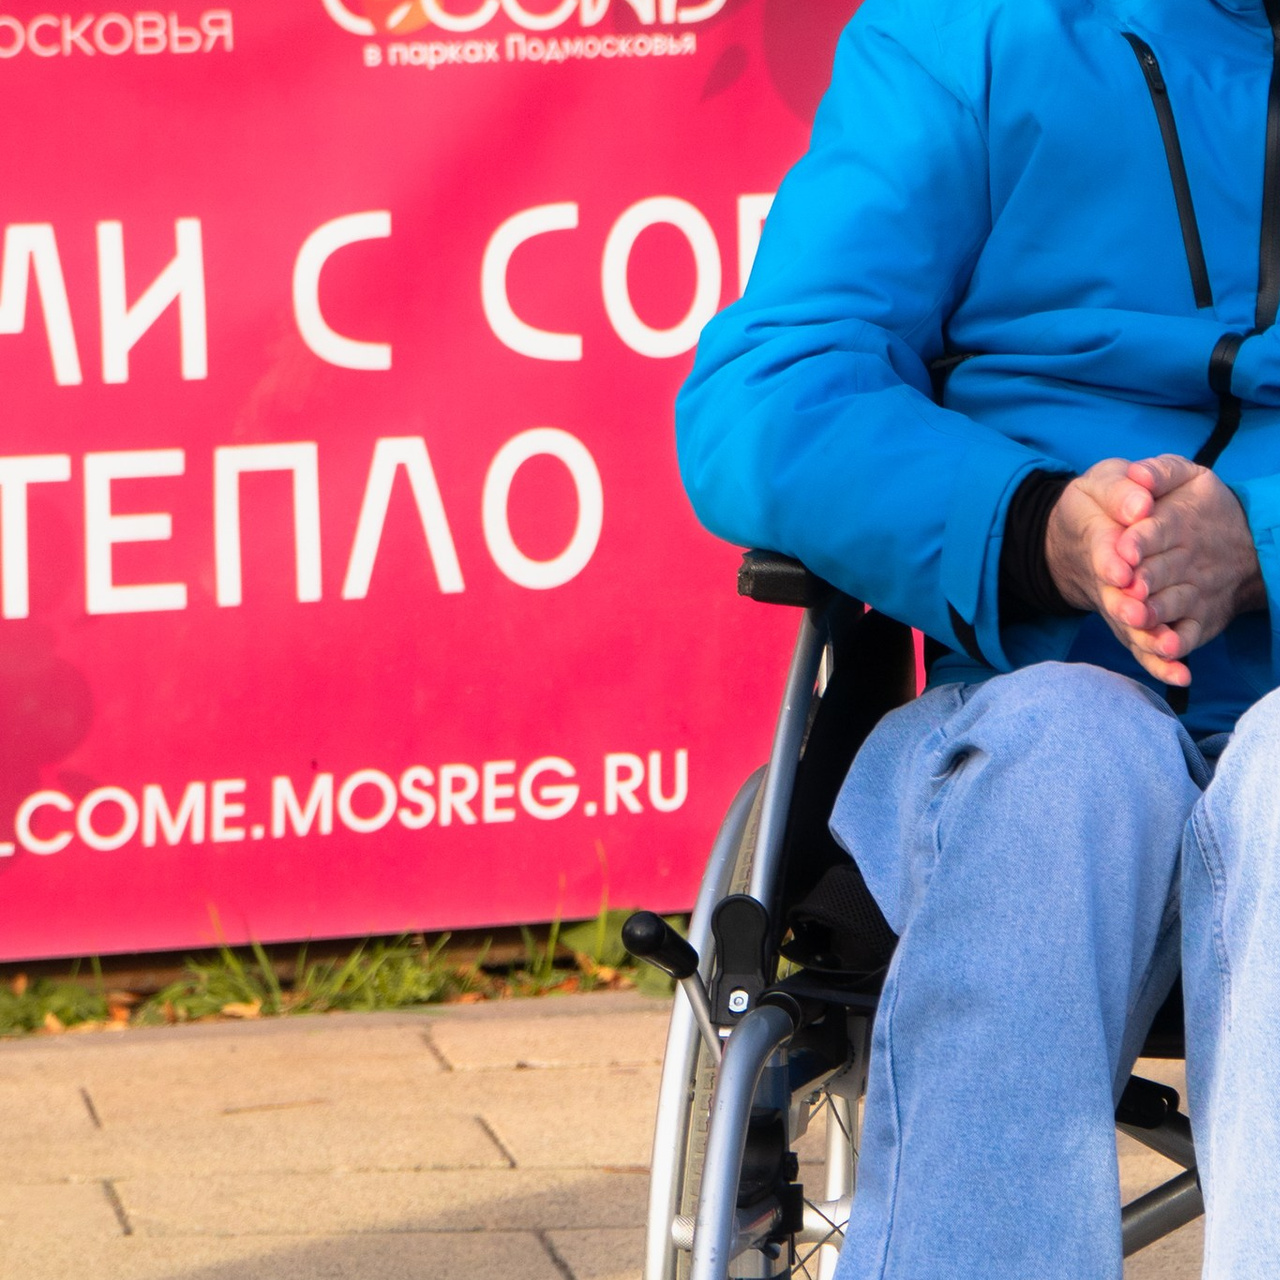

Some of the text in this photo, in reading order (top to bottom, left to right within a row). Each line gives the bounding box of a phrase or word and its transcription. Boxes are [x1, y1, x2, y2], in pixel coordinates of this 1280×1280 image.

[364, 33, 697, 70] в парках Подмосковья
[292, 210, 393, 372] С
[0, 427, 605, 620] ТЕПЛО
